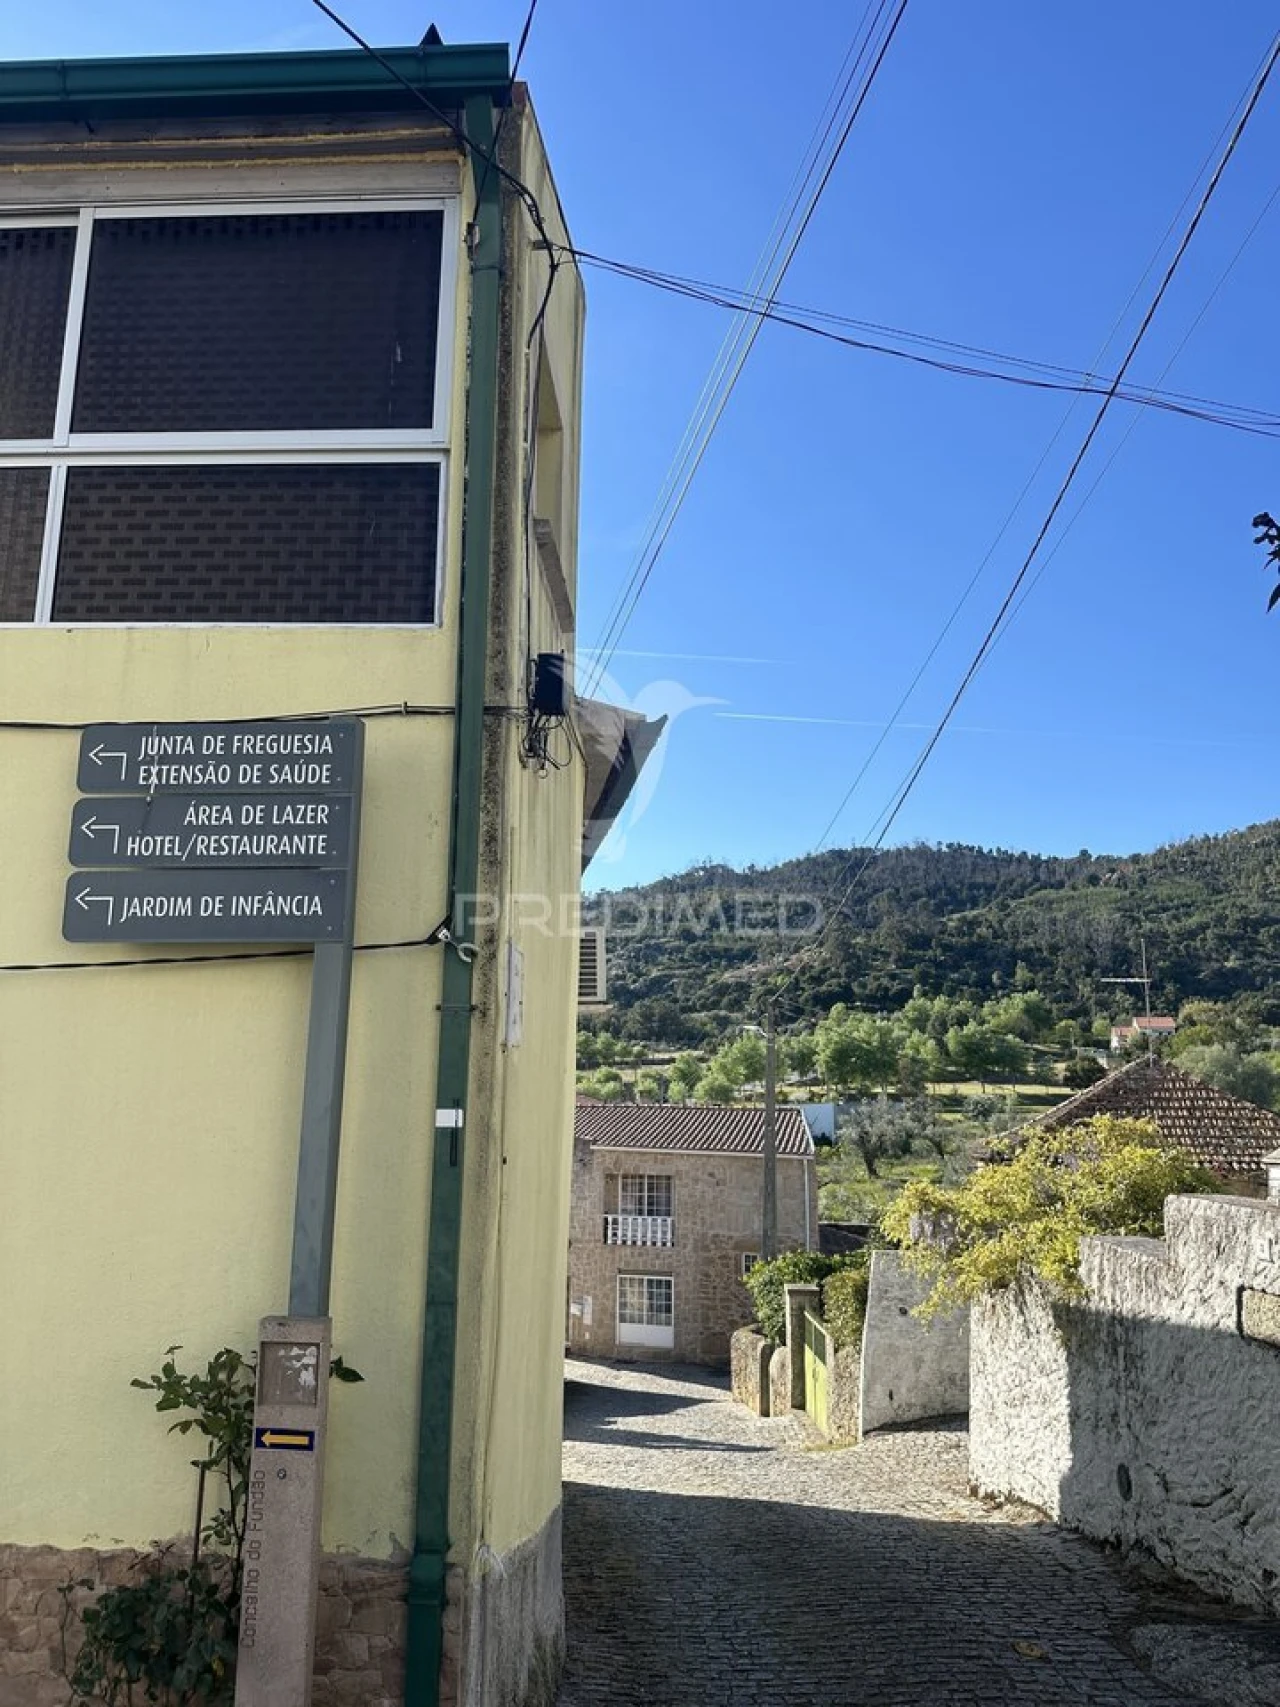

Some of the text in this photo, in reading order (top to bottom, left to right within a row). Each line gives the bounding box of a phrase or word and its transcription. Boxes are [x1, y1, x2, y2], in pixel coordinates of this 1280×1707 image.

[138, 734, 333, 761] JUNTA DE FREGUESIA
[138, 759, 331, 784] EXTENSÃO DE SAÚDE
[183, 800, 329, 825] ÁREA DE LAZER
[127, 834, 327, 861] HOTEL/RESTAURANTE
[120, 890, 323, 922] JARDIM DE INFÂNCIA
[246, 1539, 262, 1561] do
[240, 1568, 261, 1648] Concelho
